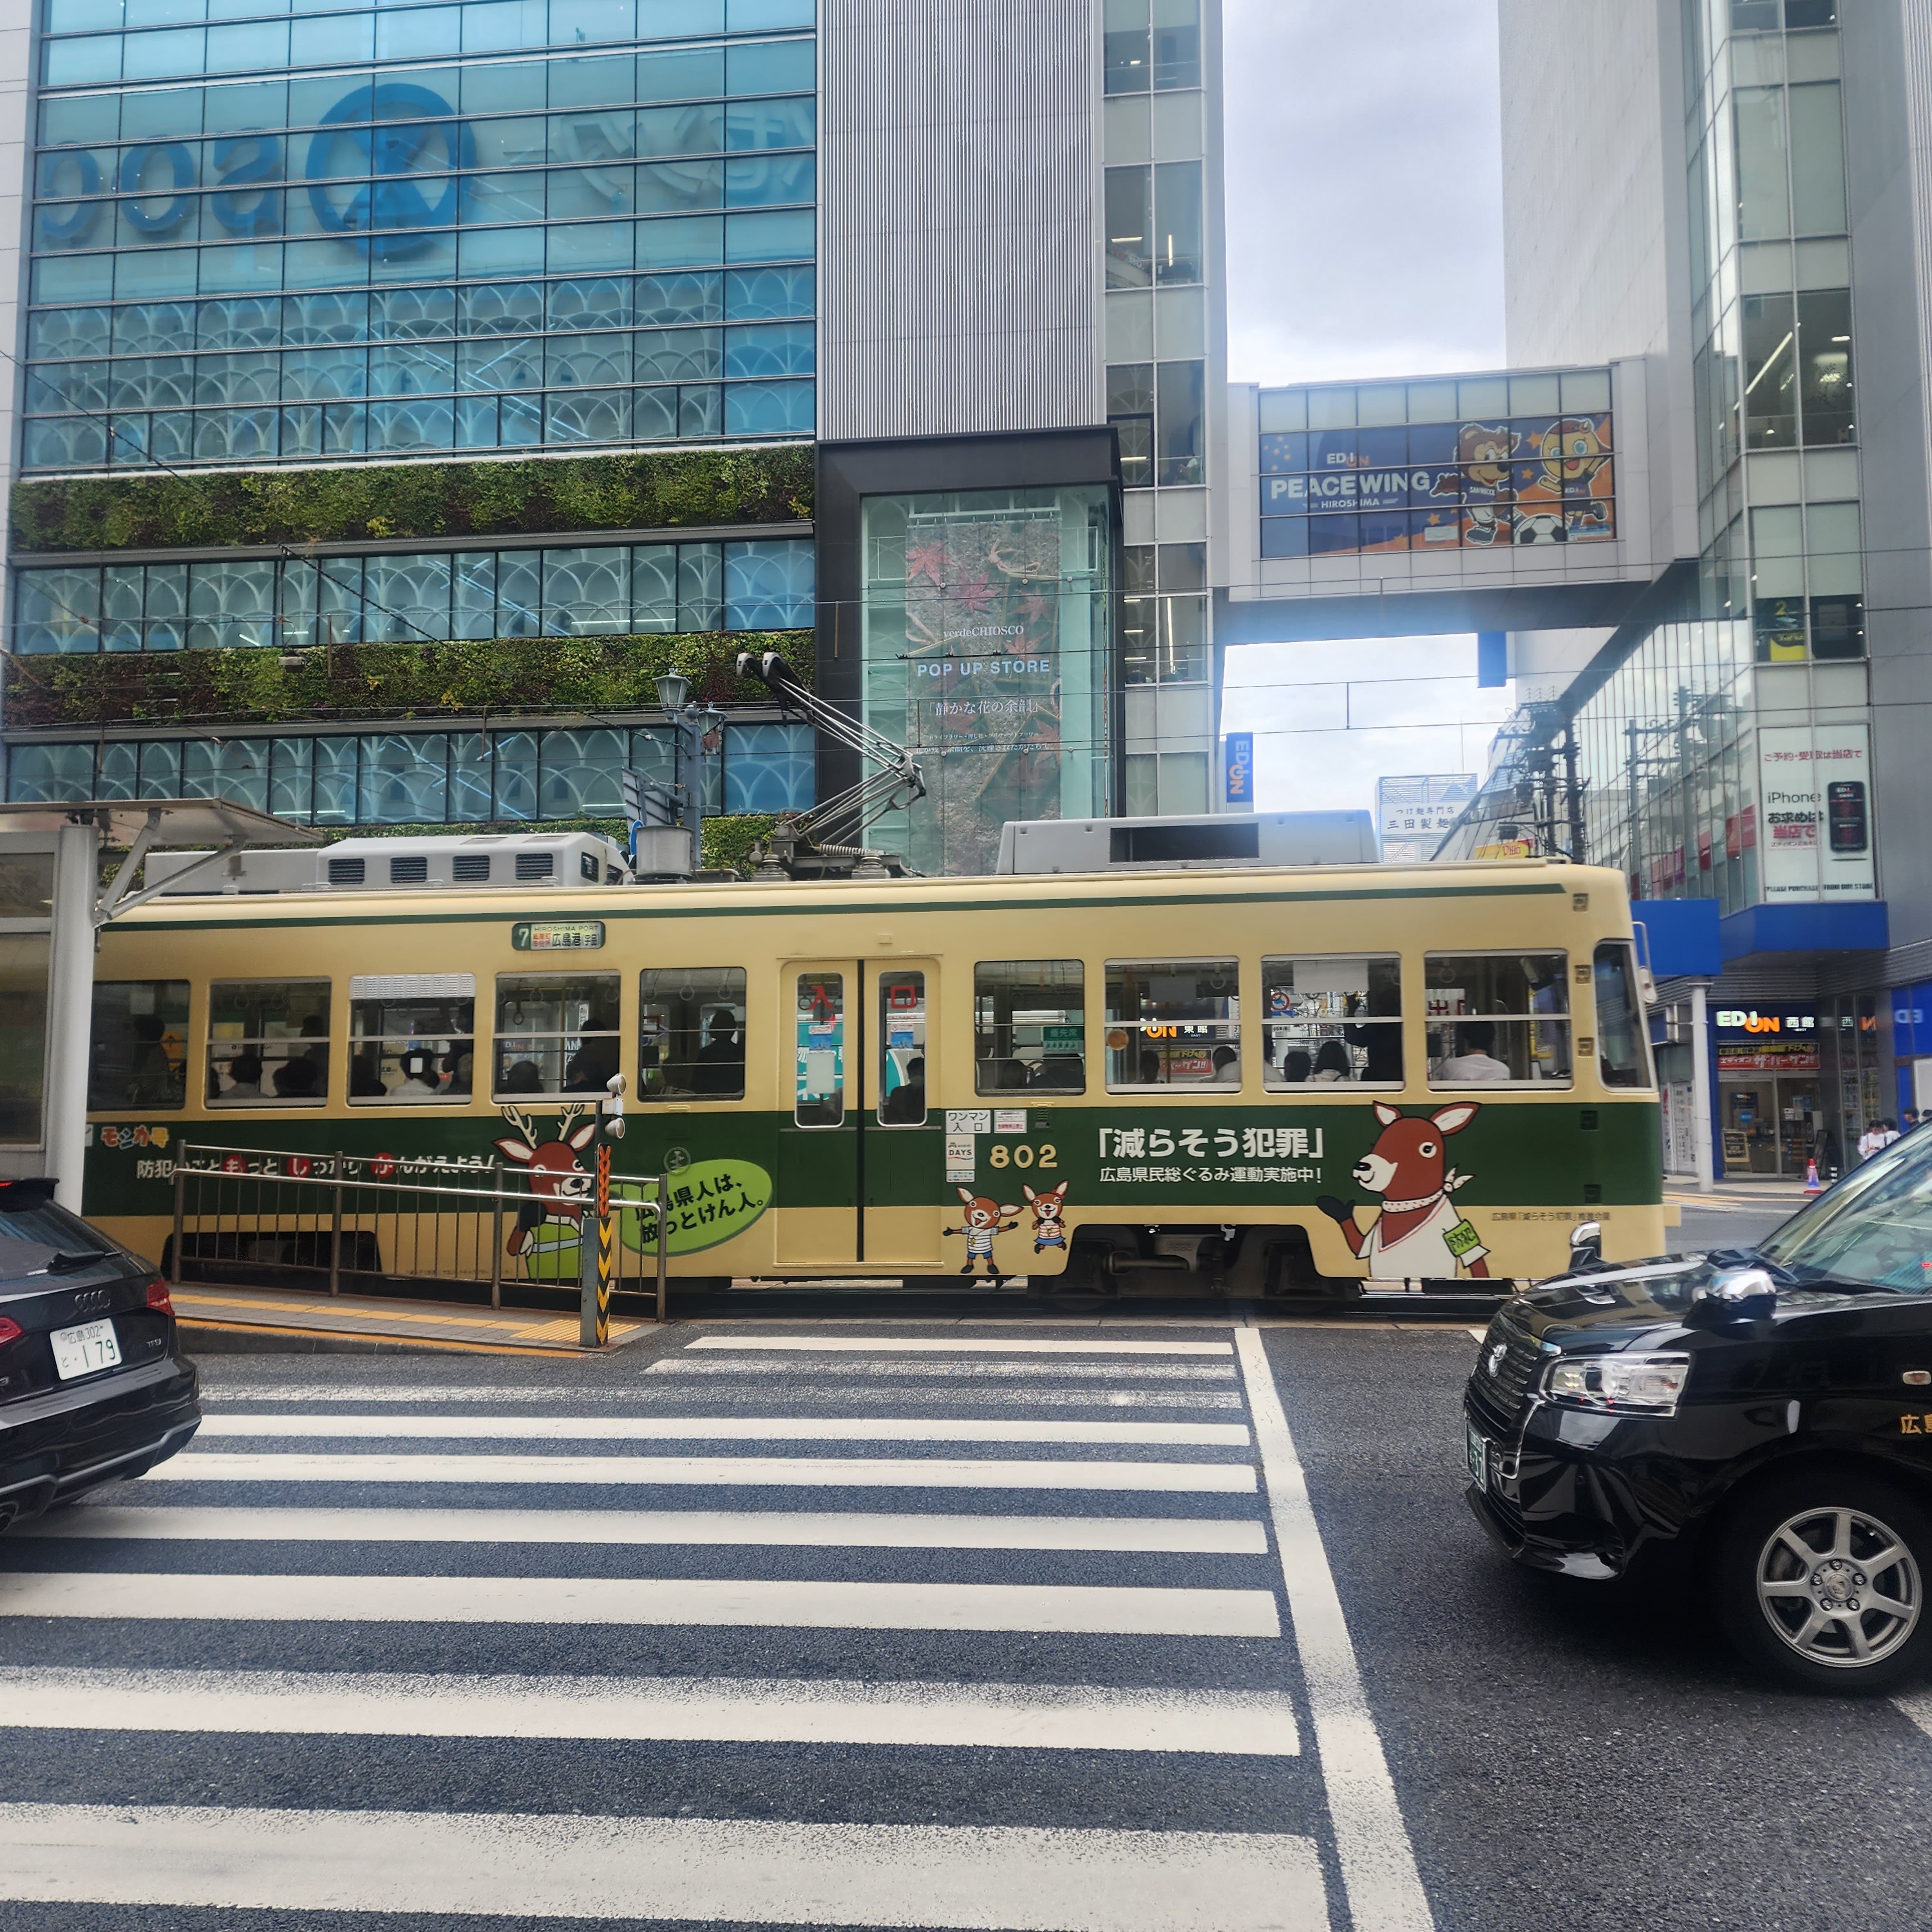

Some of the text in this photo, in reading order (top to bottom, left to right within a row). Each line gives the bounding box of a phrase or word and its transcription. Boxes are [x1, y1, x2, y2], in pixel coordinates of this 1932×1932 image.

[1321, 498, 1379, 509] HIROSHIMA
[943, 625, 1024, 638] verdeCHIOSCO
[917, 659, 1050, 677] POP UP STORE
[1229, 740, 1250, 794] EDION
[1768, 792, 1821, 804] iPhone
[1768, 811, 1824, 824] お求めは
[1774, 824, 1816, 838] 当店で
[519, 928, 529, 947] 7
[552, 933, 581, 947] 広島港
[1716, 1010, 1780, 1034] EDION
[948, 1112, 989, 1121] ワンマン
[1099, 1128, 1324, 1158] 「減らそう犯罪」
[989, 1144, 1058, 1169] 802
[1099, 1166, 1322, 1184] 広島県民総ぐるみ運動実施中!
[86, 1325, 101, 1340] 302
